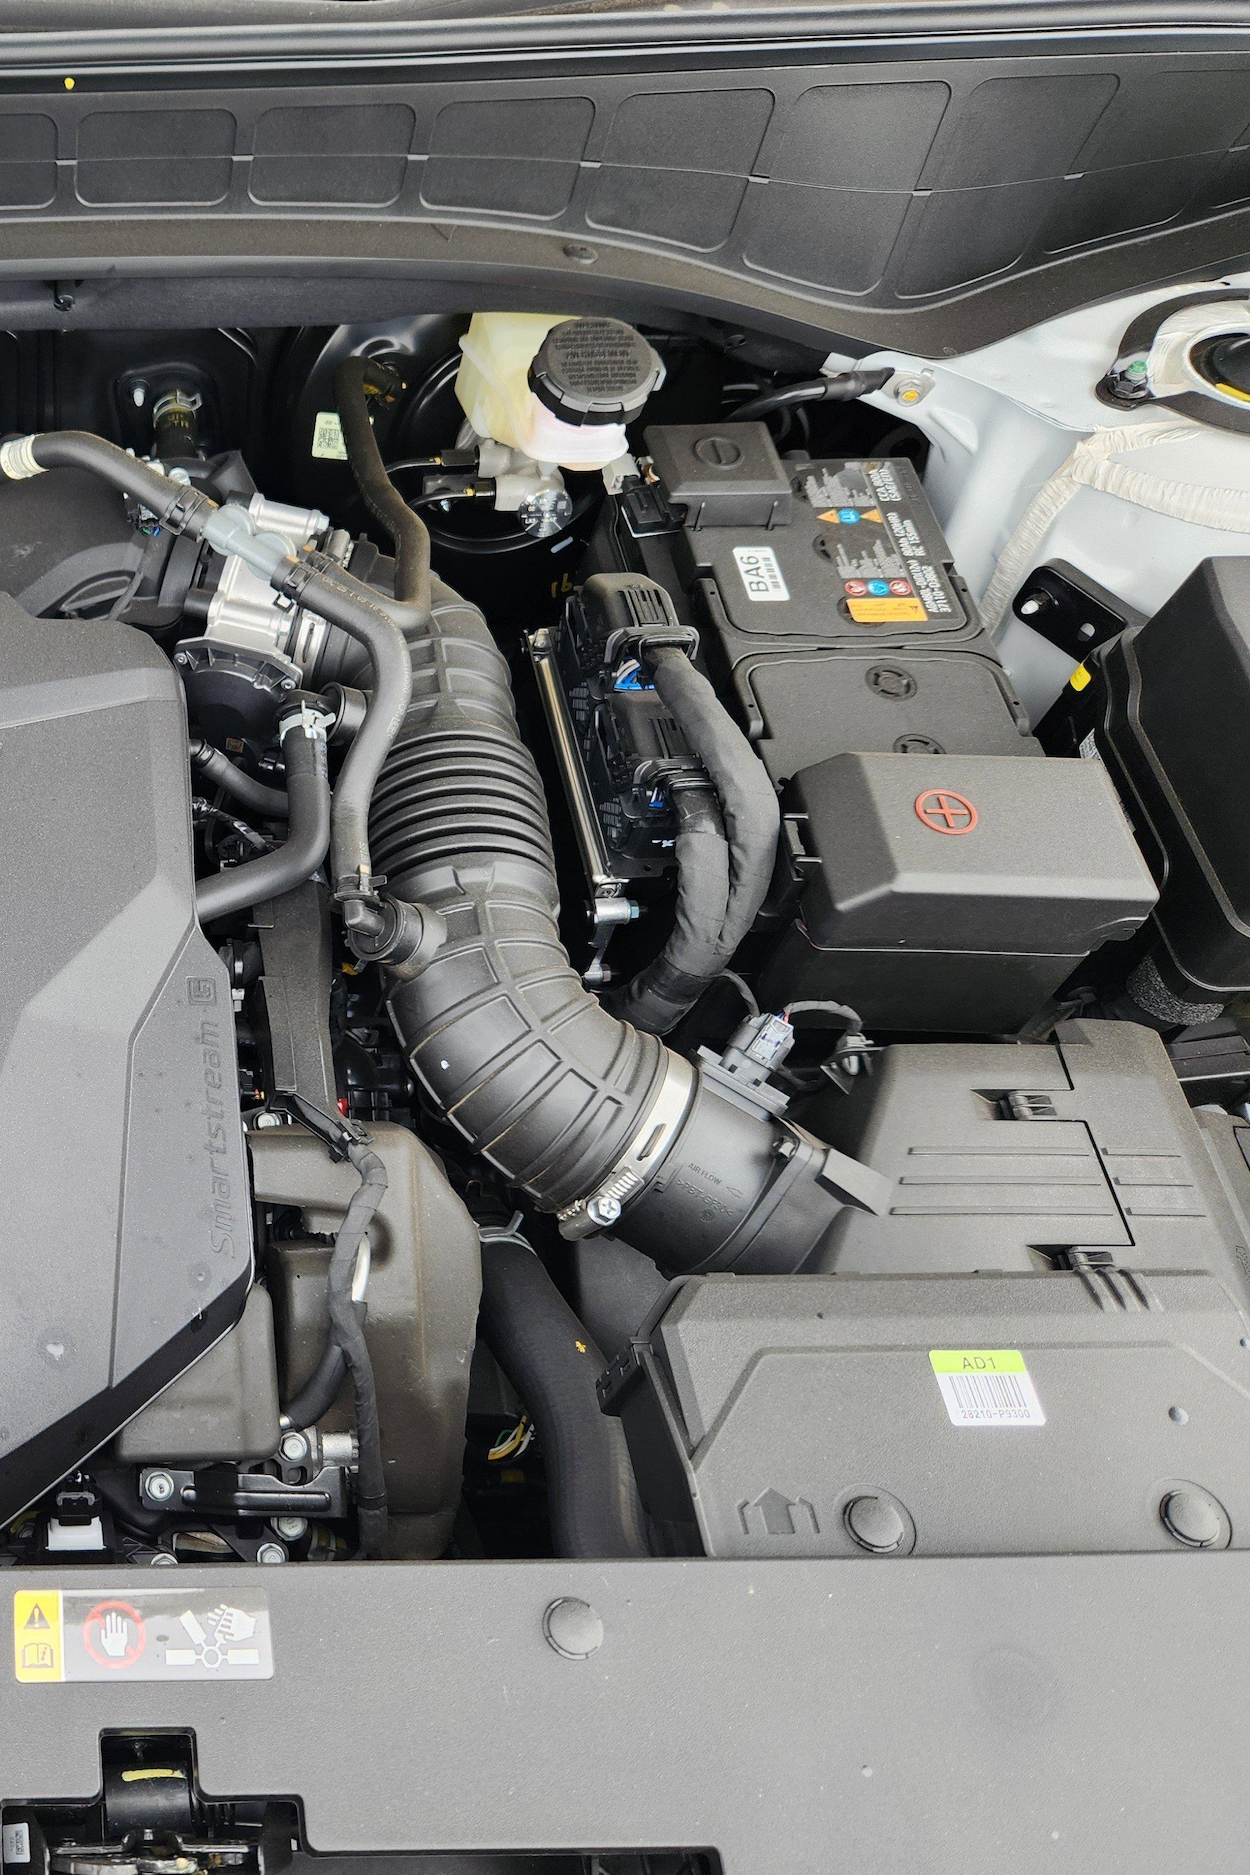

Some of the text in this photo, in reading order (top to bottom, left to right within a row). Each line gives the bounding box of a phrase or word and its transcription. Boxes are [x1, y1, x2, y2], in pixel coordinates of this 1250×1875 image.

[876, 488, 890, 502] CCA
[903, 519, 921, 545] 155min
[912, 545, 926, 557] RC
[740, 555, 770, 592] BA6
[200, 1020, 236, 1259] Smartstream
[688, 1163, 722, 1186] AIR FLOW
[962, 1357, 996, 1370] AD1
[961, 1409, 1031, 1419] 28210-P9300
